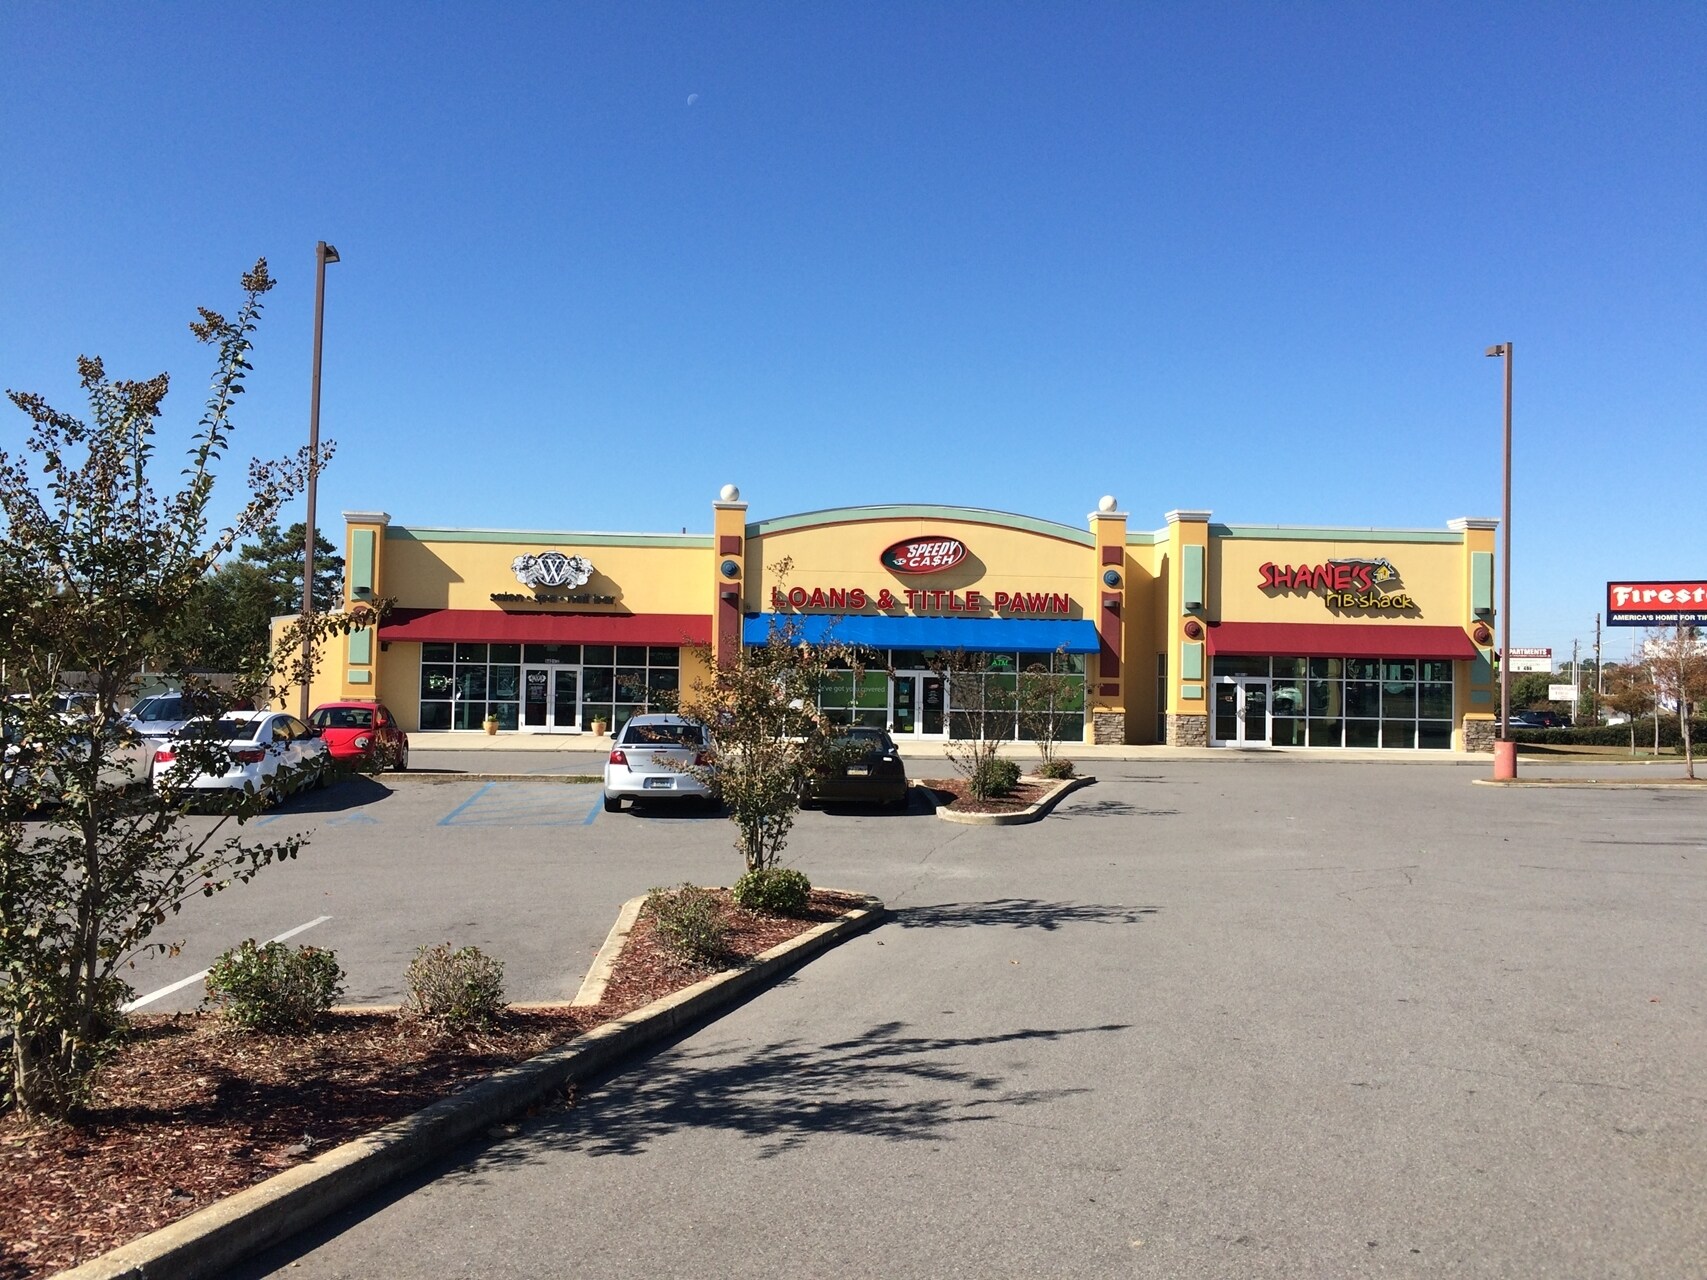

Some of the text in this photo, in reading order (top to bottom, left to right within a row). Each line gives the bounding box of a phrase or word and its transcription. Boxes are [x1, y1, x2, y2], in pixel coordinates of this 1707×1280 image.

[906, 541, 959, 558] SPEEDY
[539, 559, 569, 583] W
[1257, 562, 1373, 592] SHANE'S
[772, 586, 1070, 614] LOANS & TITLE PAWN
[1358, 591, 1414, 609] shack
[1612, 586, 1707, 607] Firest
[991, 659, 1009, 667] ATM
[834, 684, 844, 693] got
